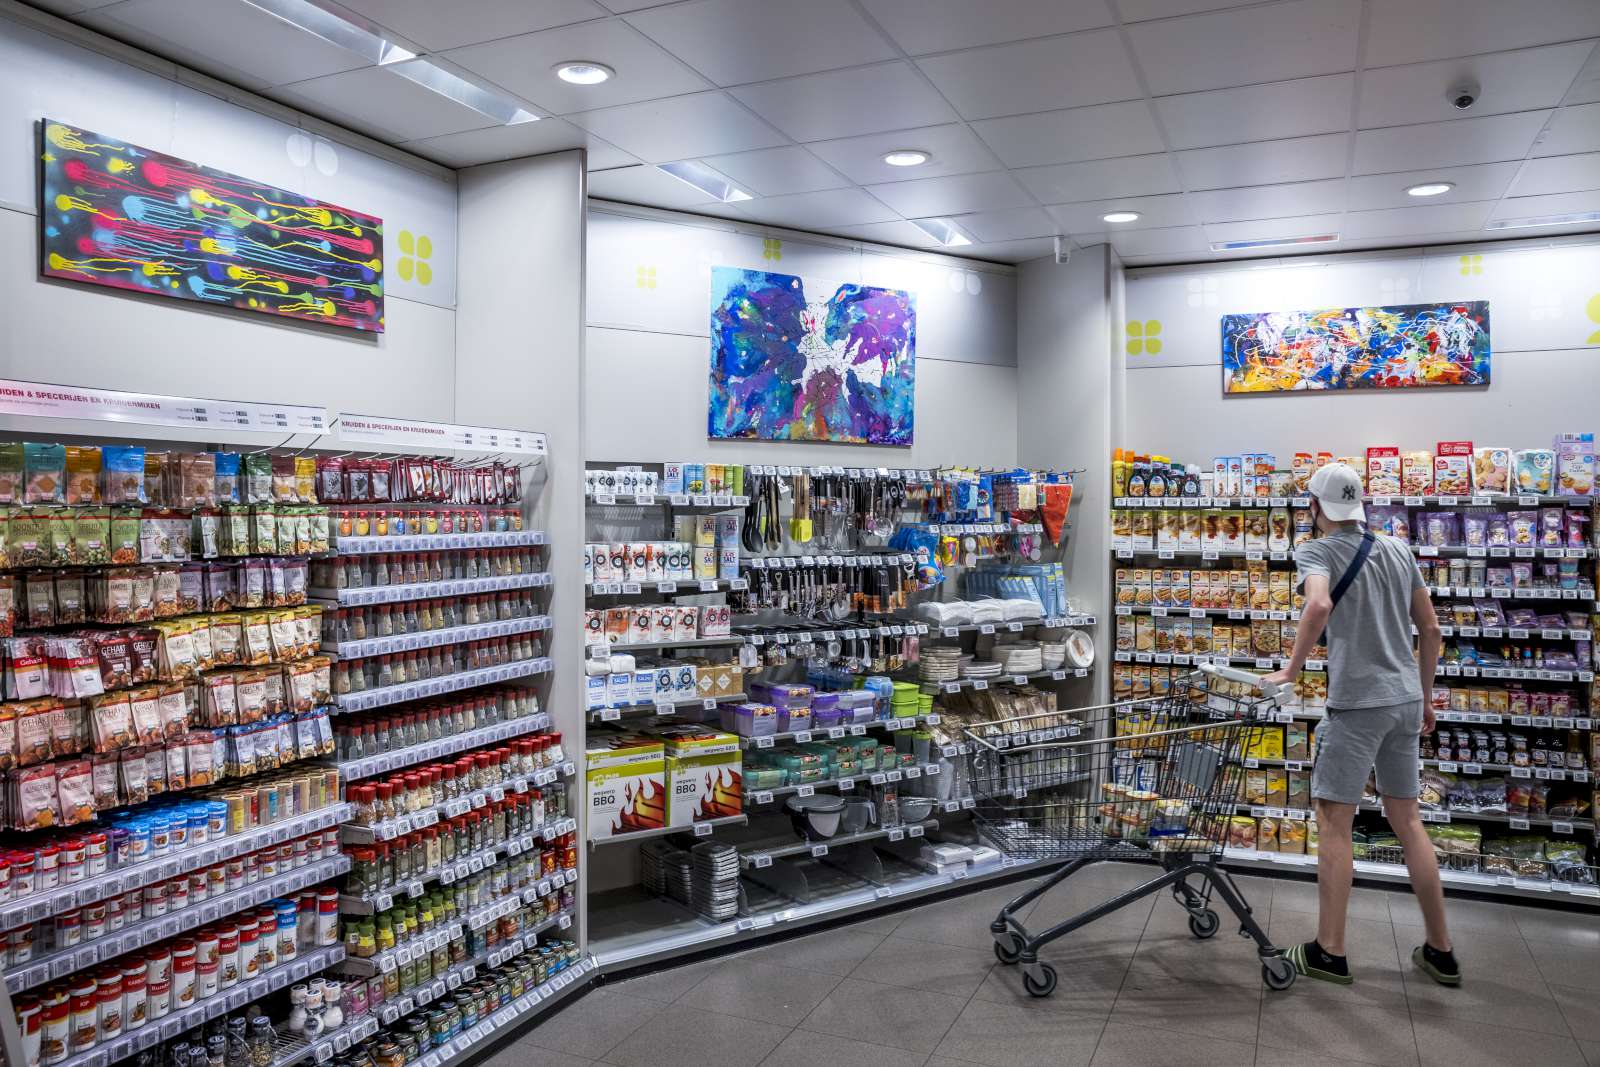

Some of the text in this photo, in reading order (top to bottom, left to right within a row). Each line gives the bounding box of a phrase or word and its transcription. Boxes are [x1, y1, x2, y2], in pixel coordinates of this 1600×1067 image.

[27, 390, 34, 398] &
[35, 392, 88, 403] SPECERIJEN
[103, 398, 161, 410] KRUIDENMIXEN
[341, 420, 365, 428] KRUIDEN
[371, 423, 401, 431] SPECERIJEN
[101, 644, 126, 656] GEHAKT
[133, 640, 154, 651] GEHAKT
[19, 657, 43, 666] Gehakt
[676, 783, 696, 795] BBQ
[593, 795, 616, 807] BBQ
